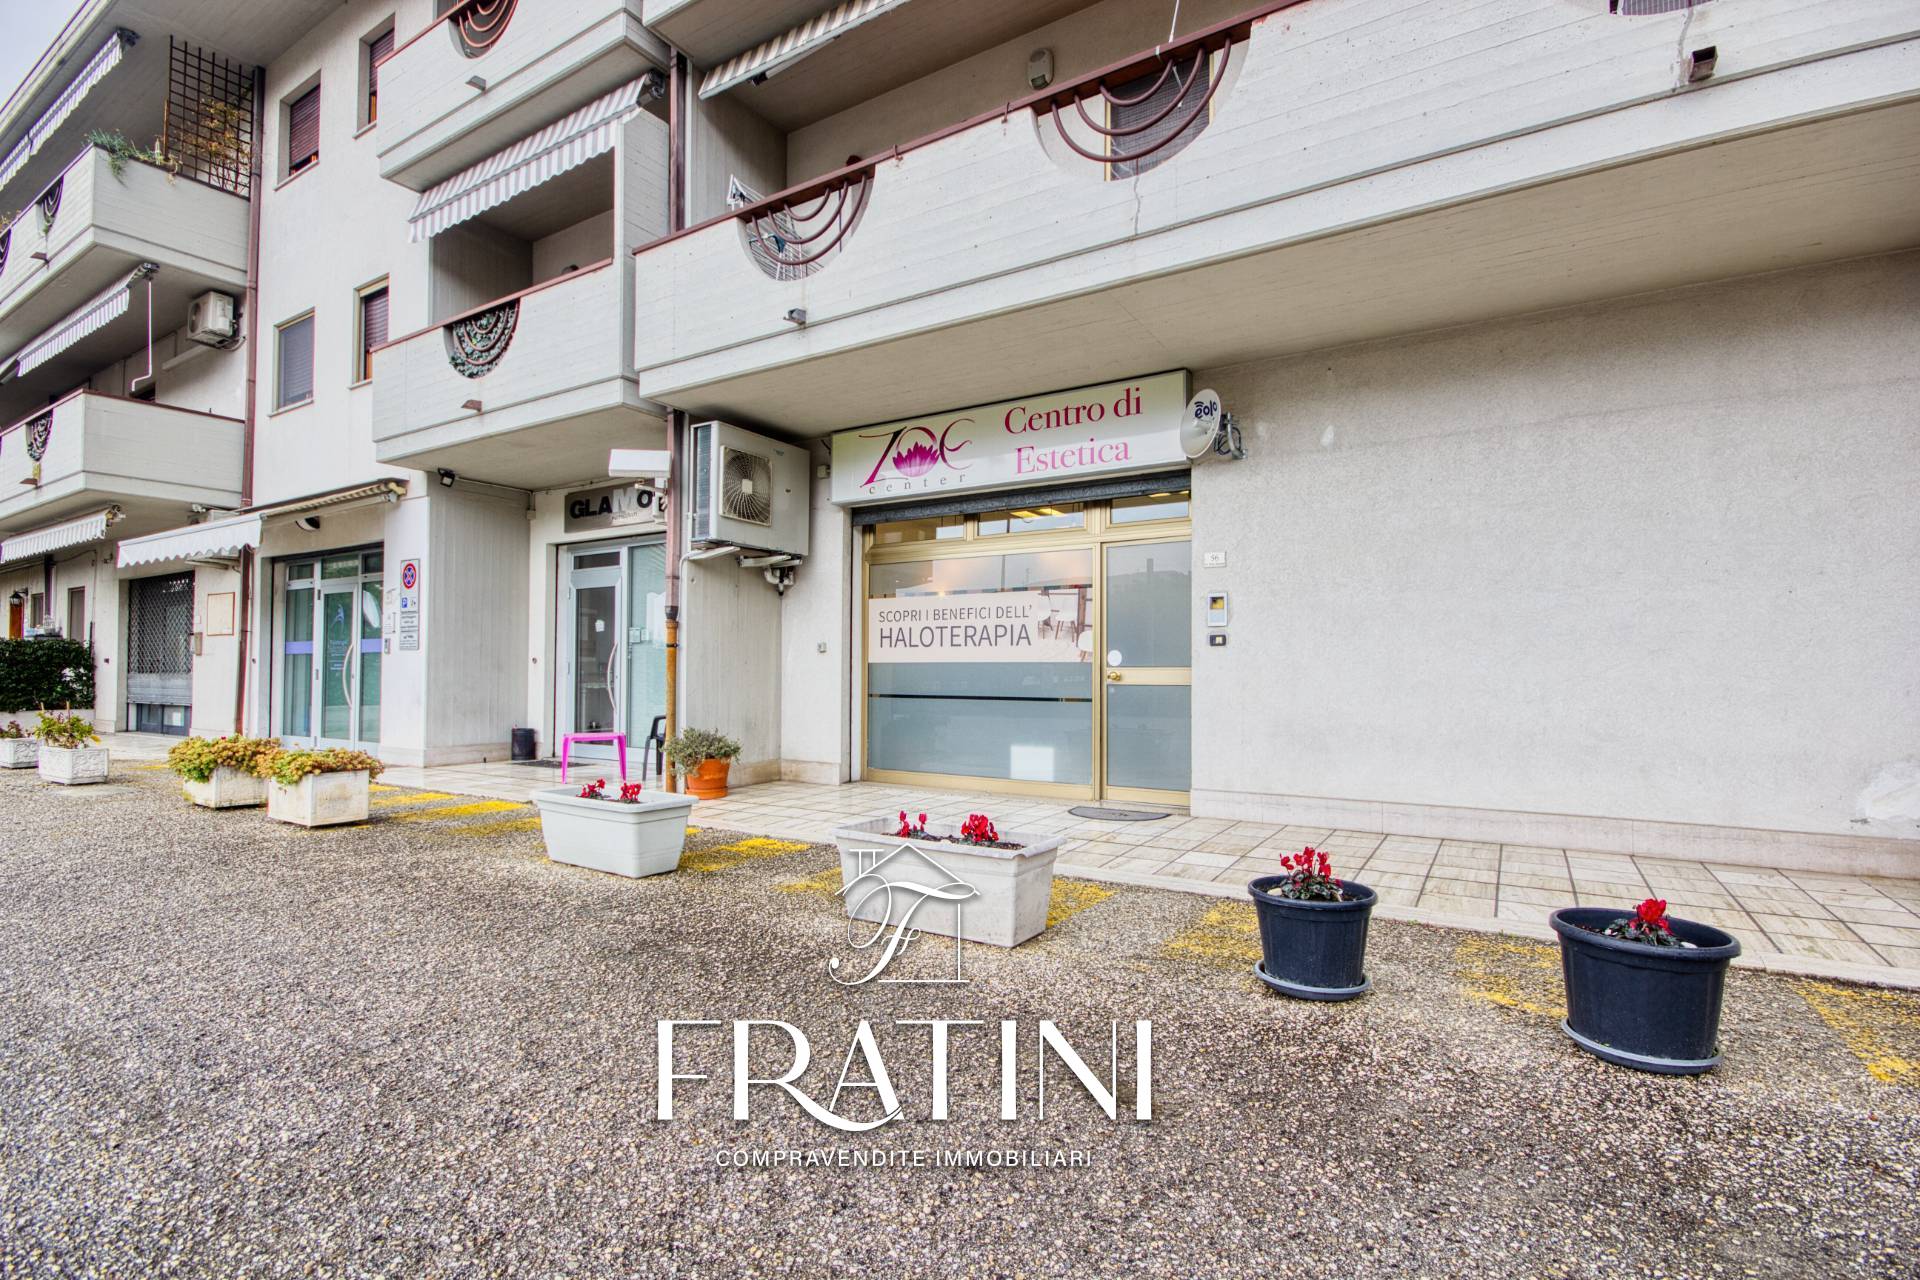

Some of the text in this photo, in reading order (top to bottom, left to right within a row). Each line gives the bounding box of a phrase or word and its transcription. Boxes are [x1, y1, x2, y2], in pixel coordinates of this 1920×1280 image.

[1004, 386, 1143, 435] Centro di
[1015, 437, 1132, 475] Estetica
[869, 473, 966, 495] center
[879, 604, 1033, 623] SCOPRI I BENEFICI DELL'
[880, 624, 1032, 648] HALOTERAPIA
